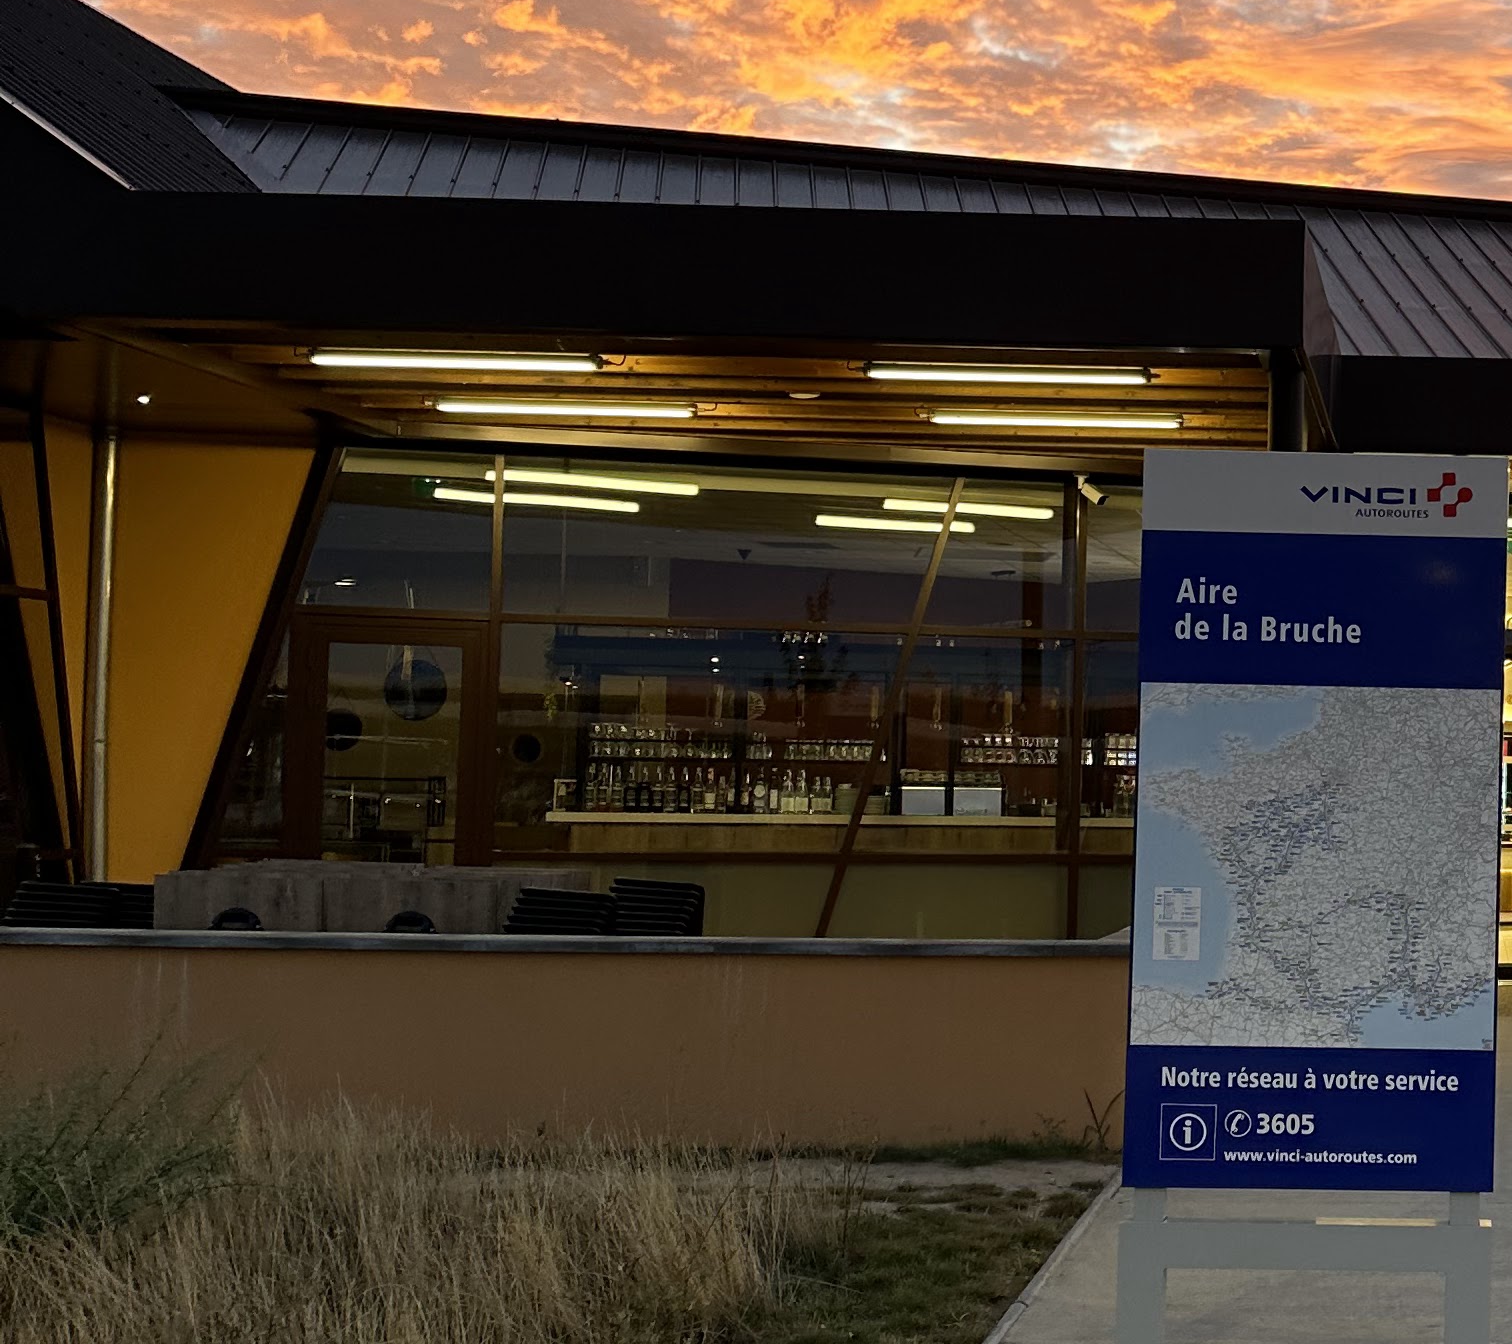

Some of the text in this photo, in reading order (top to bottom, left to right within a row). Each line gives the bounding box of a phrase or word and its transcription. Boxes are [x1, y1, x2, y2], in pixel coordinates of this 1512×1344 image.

[1300, 485, 1416, 505] VINCI
[1355, 508, 1430, 519] AUTOROUTES
[1176, 576, 1238, 604] Aire
[1175, 613, 1362, 644] de la Bruche
[1161, 1066, 1459, 1092] Notre réseau à votre service
[1256, 1112, 1315, 1135] 3605
[1223, 1149, 1418, 1165] www.vinci-autoroutes.com
